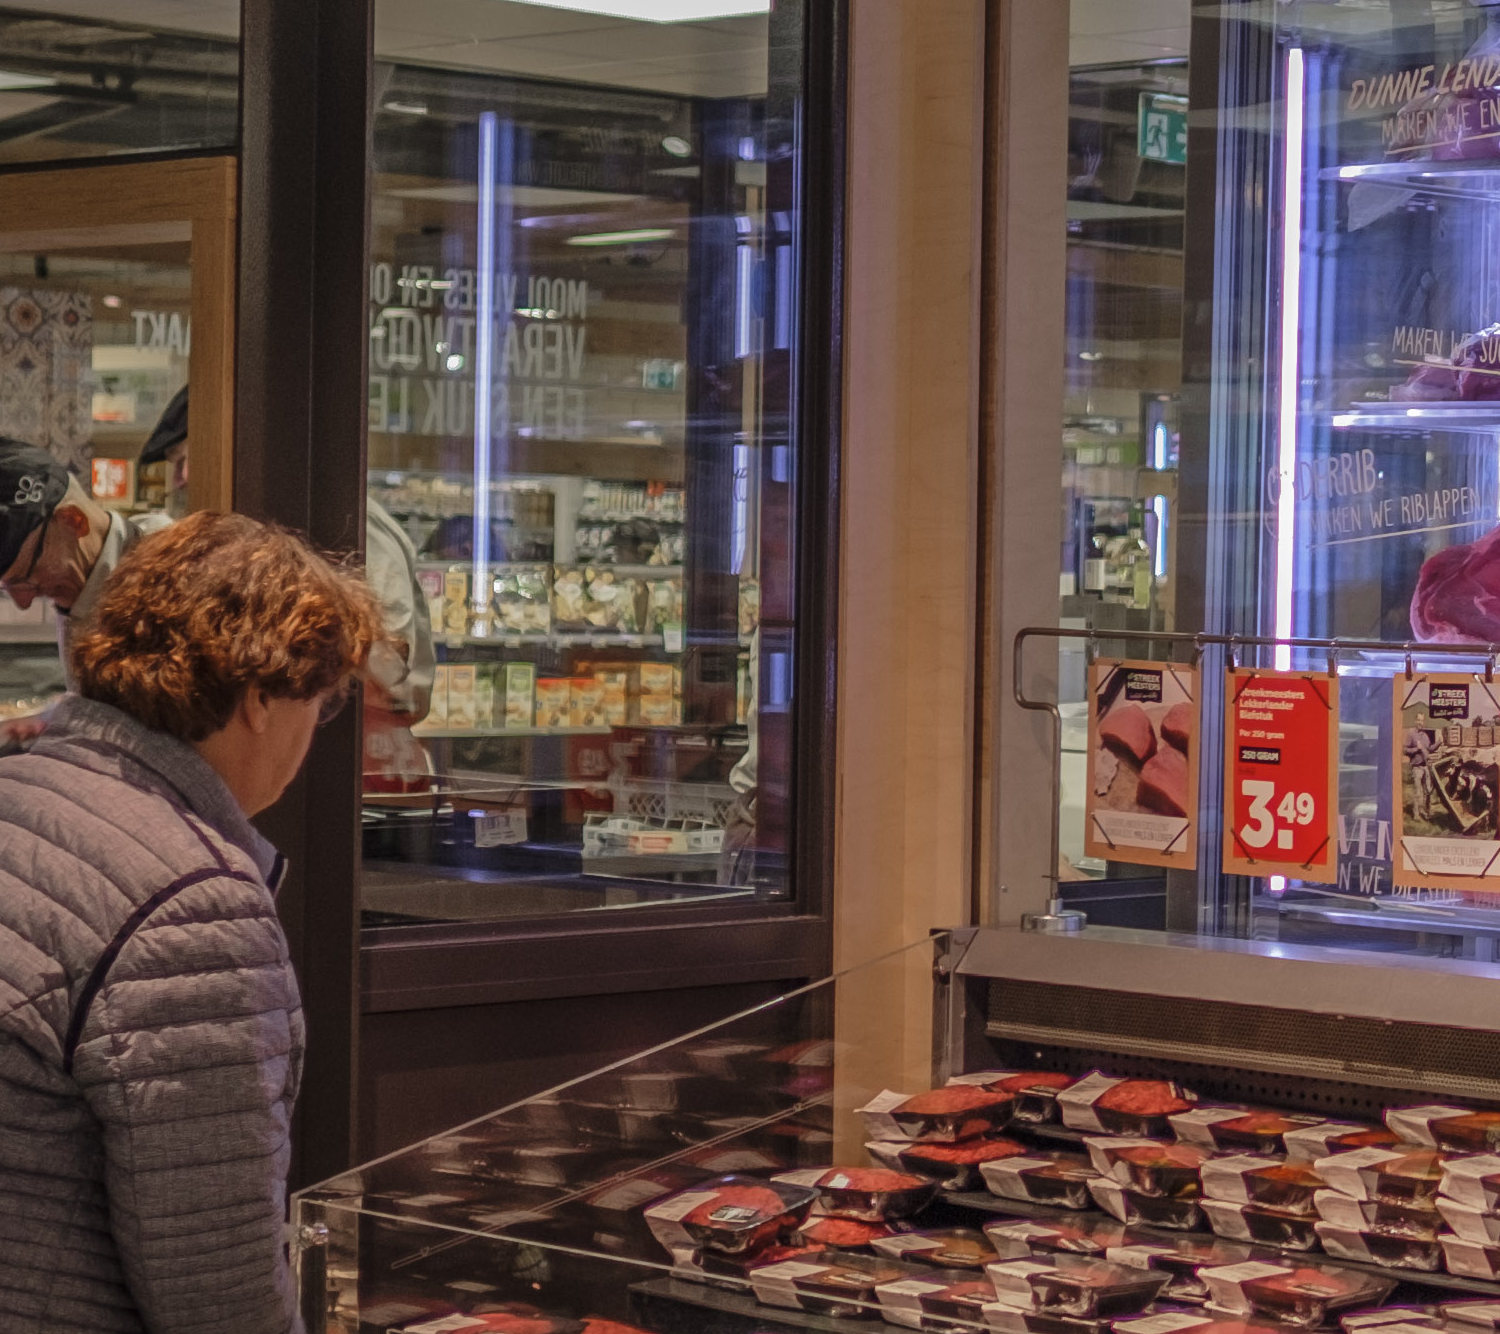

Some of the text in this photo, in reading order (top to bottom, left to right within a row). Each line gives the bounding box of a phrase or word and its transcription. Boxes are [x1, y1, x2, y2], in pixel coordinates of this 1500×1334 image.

[1348, 65, 1434, 110] DUNNE
[1392, 325, 1443, 356] MAKEN
[1267, 448, 1376, 506] ODERRIB
[1370, 498, 1394, 529] WE
[1402, 486, 1482, 525] RIBLAPPEN
